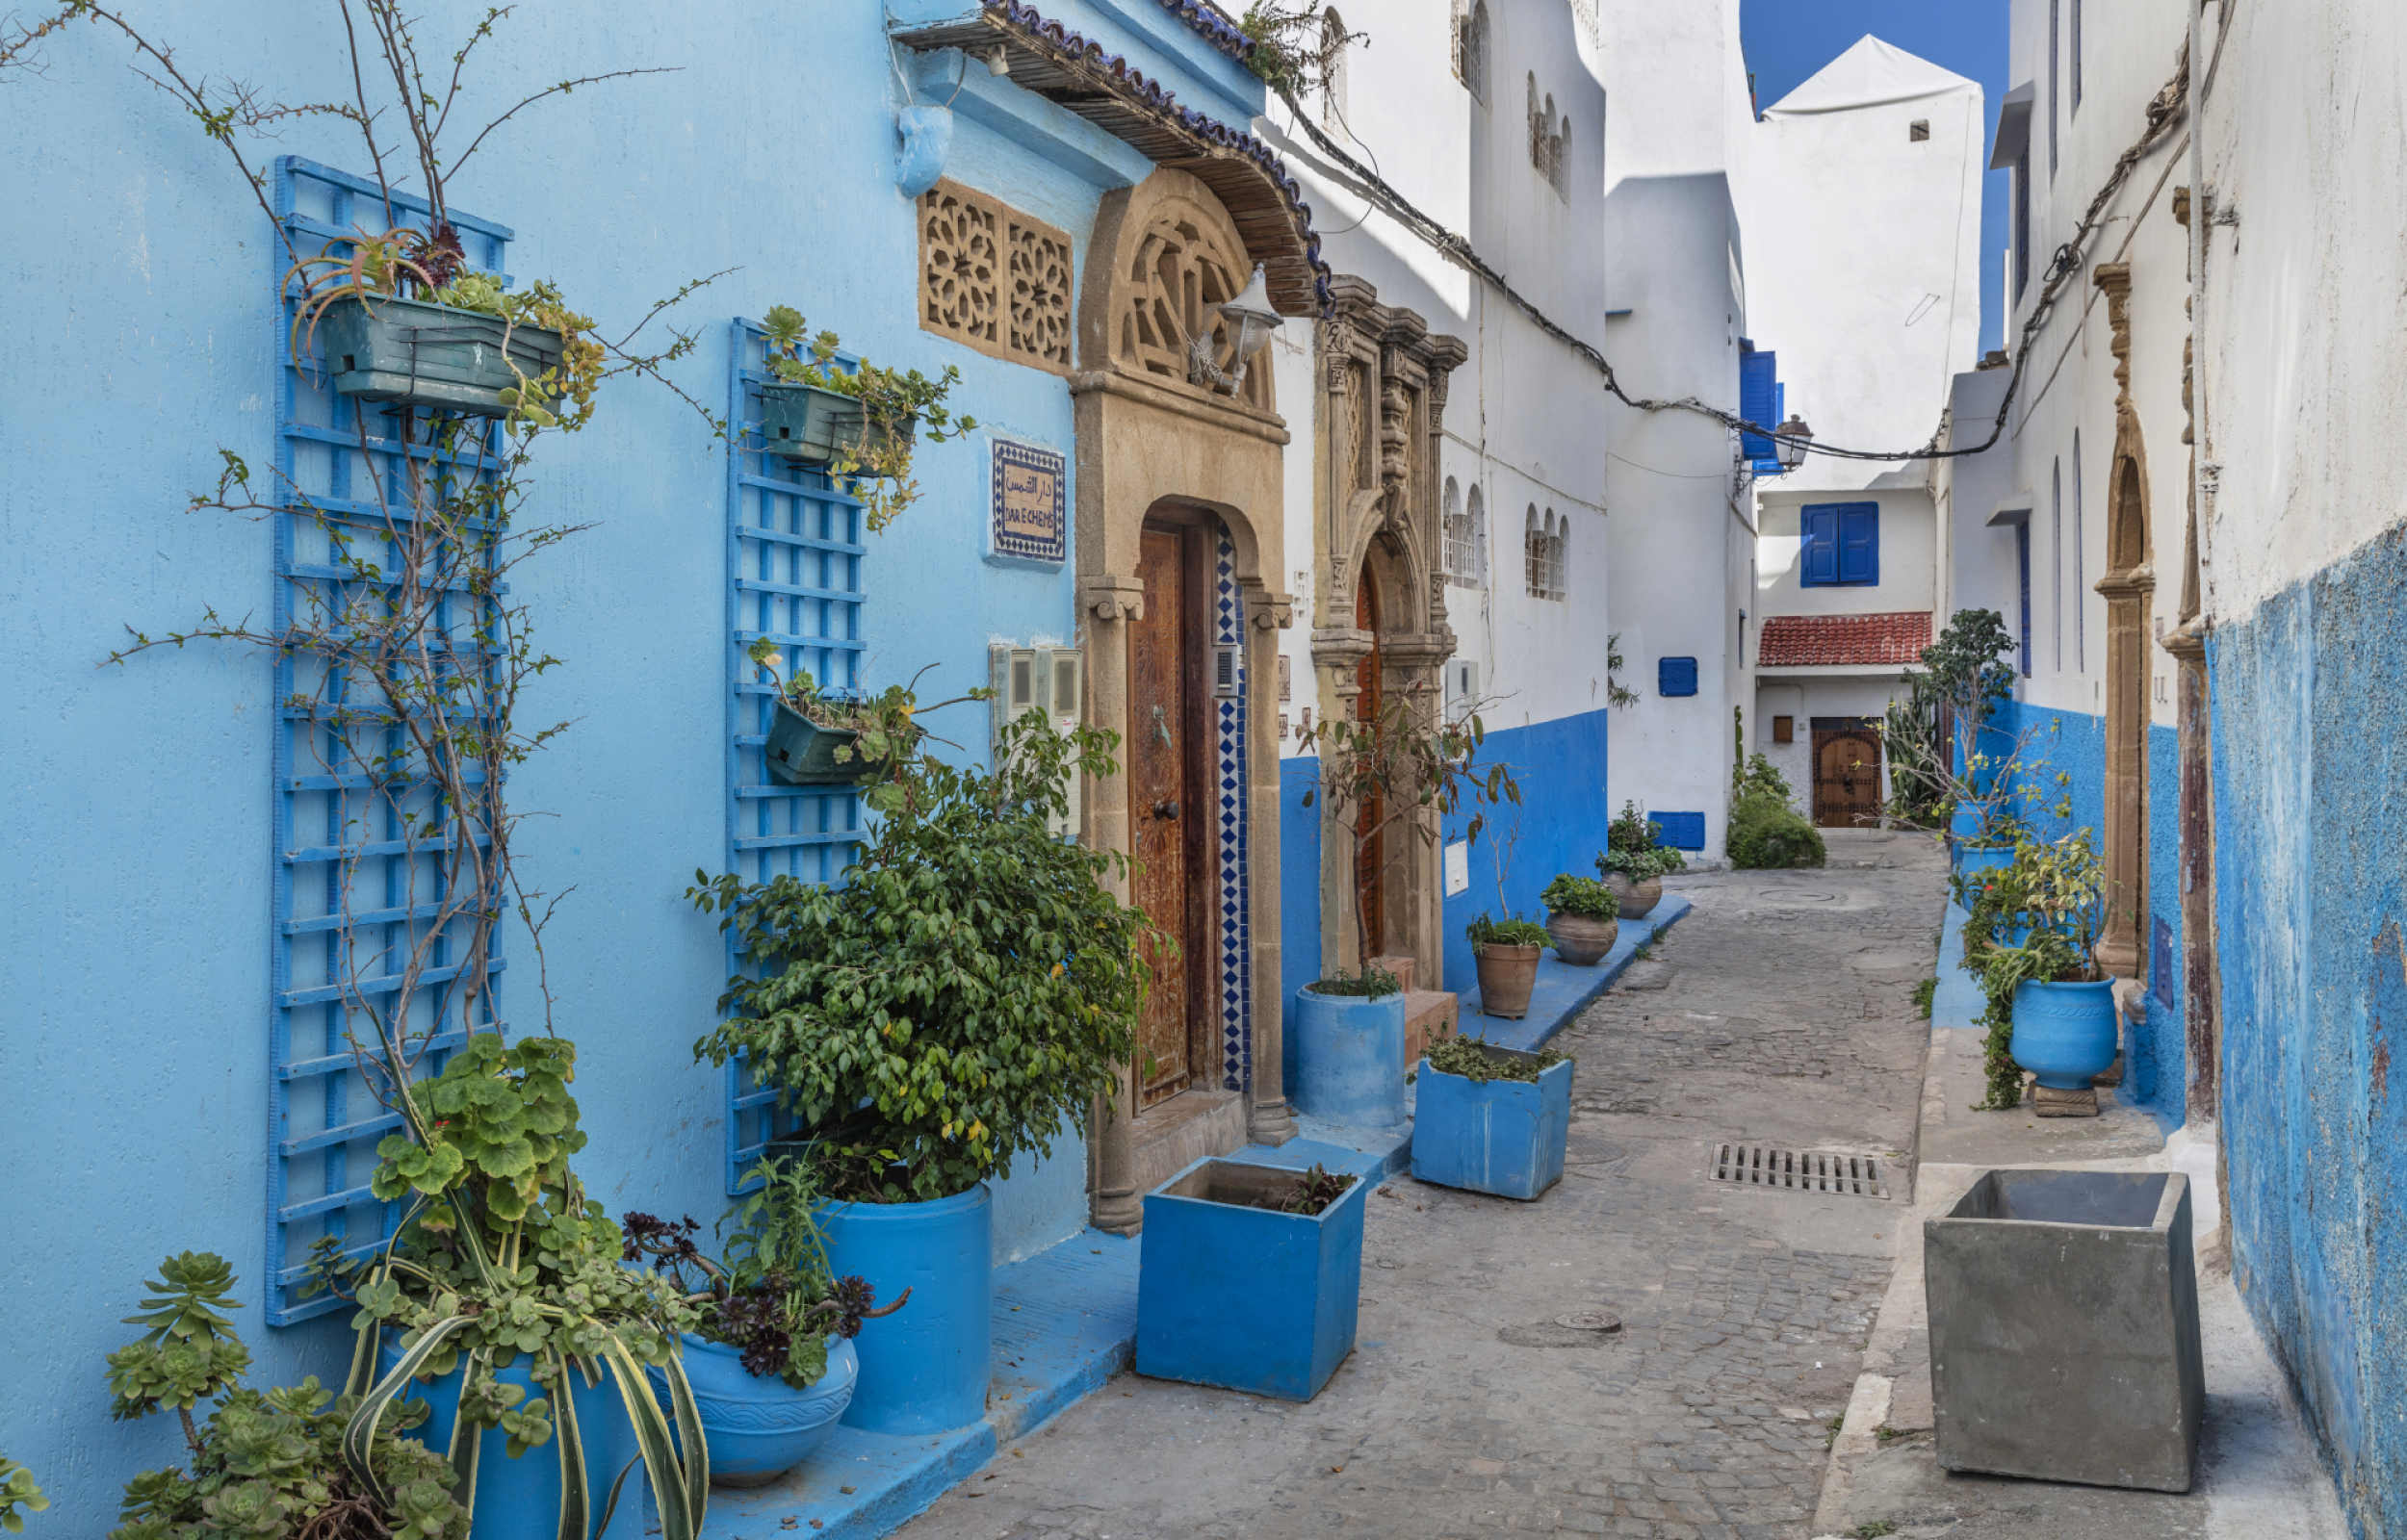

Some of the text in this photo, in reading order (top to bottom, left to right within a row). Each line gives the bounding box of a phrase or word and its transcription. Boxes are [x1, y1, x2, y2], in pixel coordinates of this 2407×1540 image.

[1005, 475, 1051, 503] دار الشمس
[1005, 506, 1021, 524] DAR
